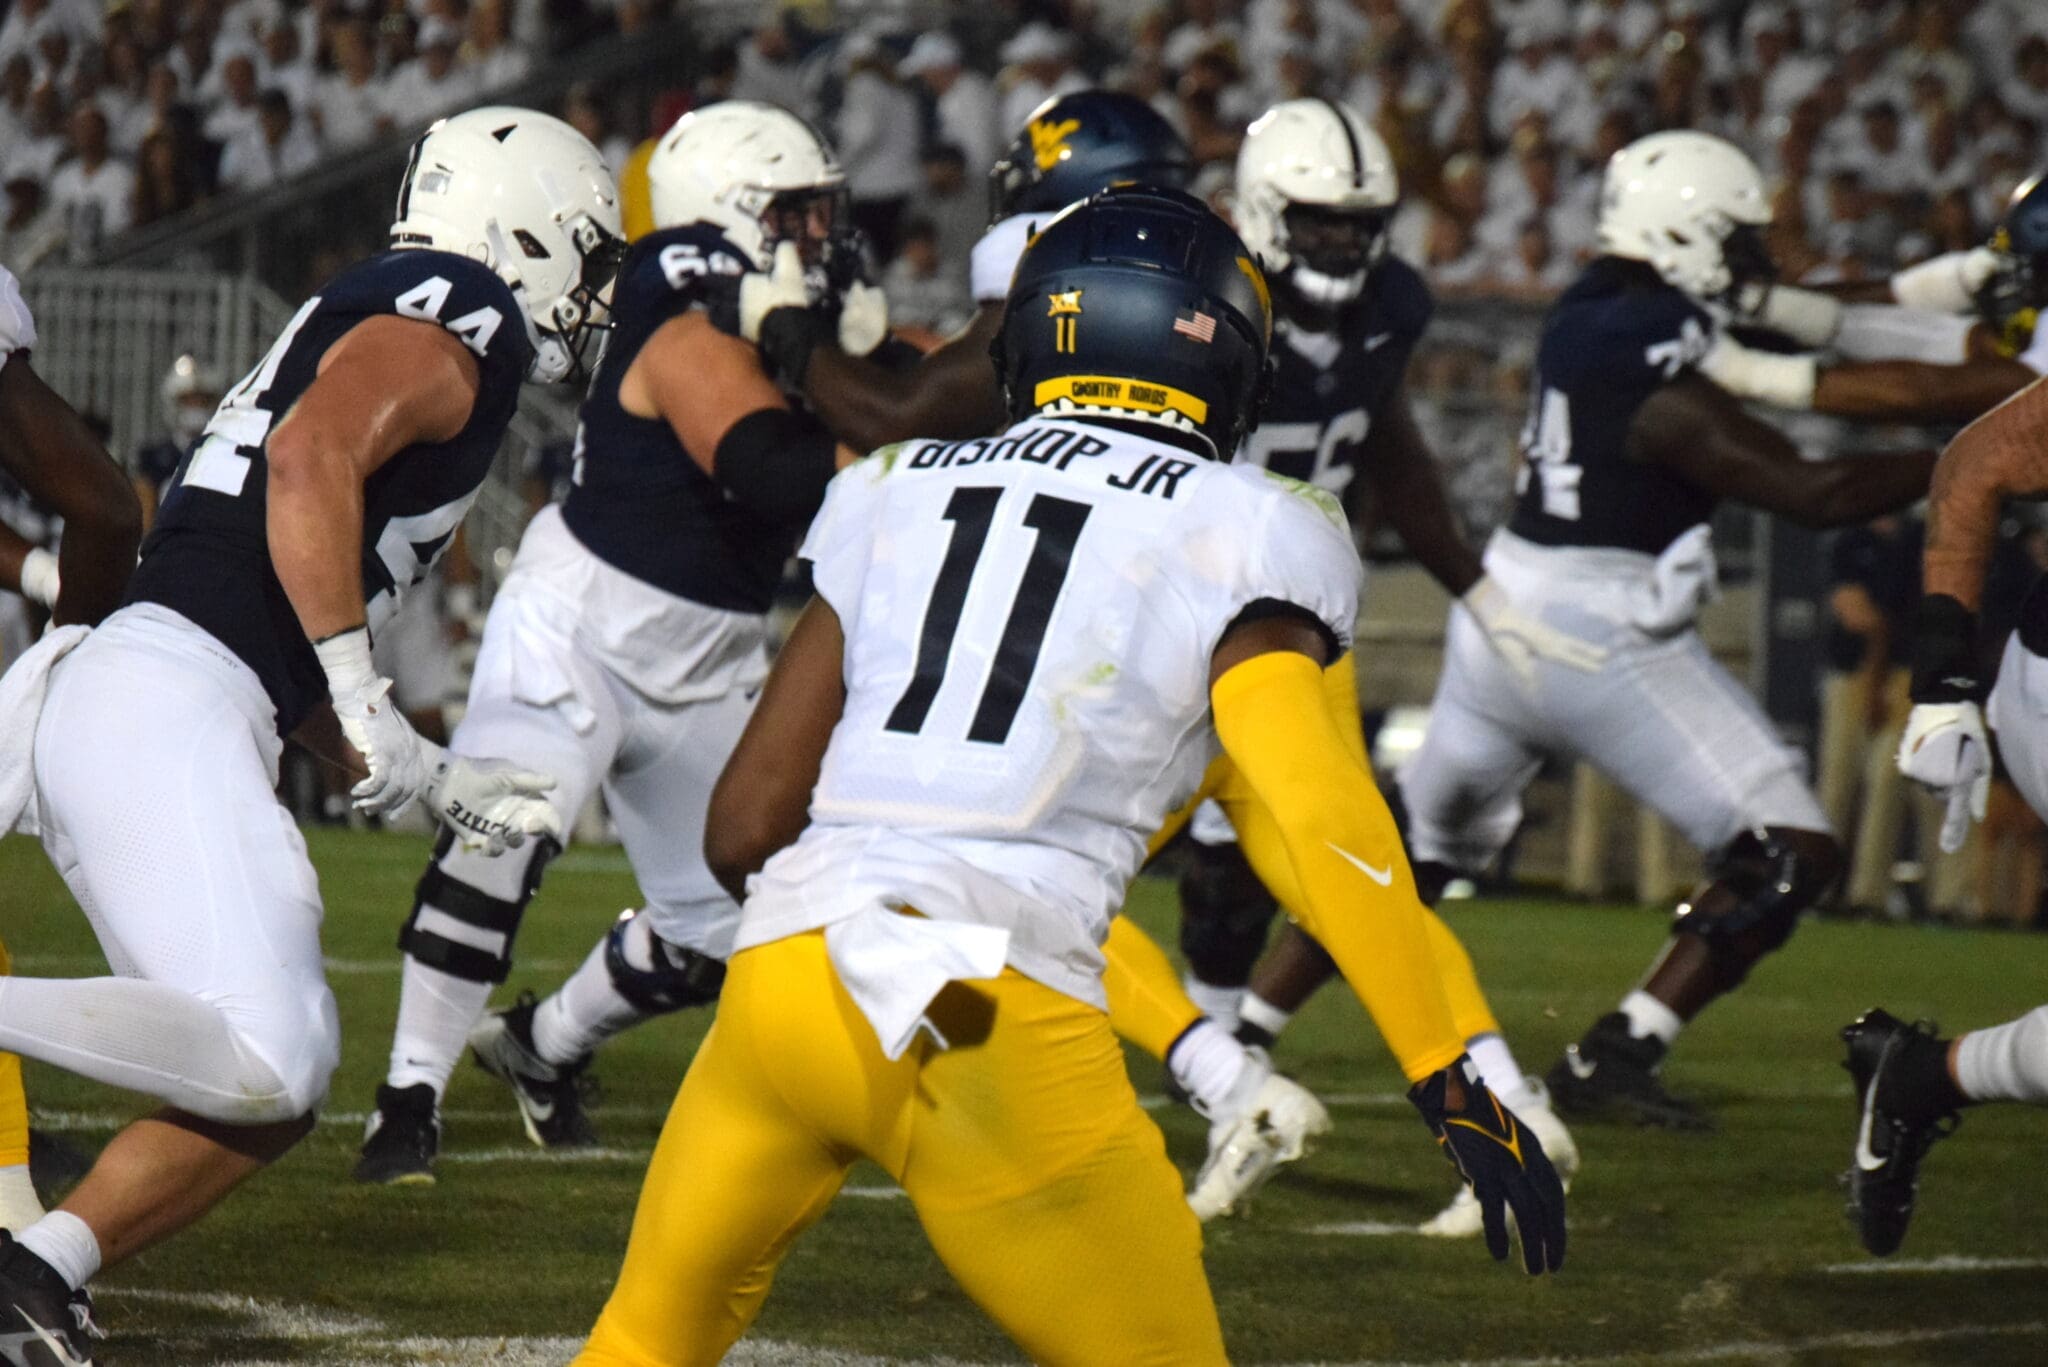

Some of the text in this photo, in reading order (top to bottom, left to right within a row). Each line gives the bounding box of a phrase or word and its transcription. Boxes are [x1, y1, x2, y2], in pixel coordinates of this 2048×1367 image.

[395, 275, 503, 357] 44
[1056, 317, 1077, 354] 11
[908, 427, 1198, 500] BISHOP JR
[883, 486, 1094, 746] 11
